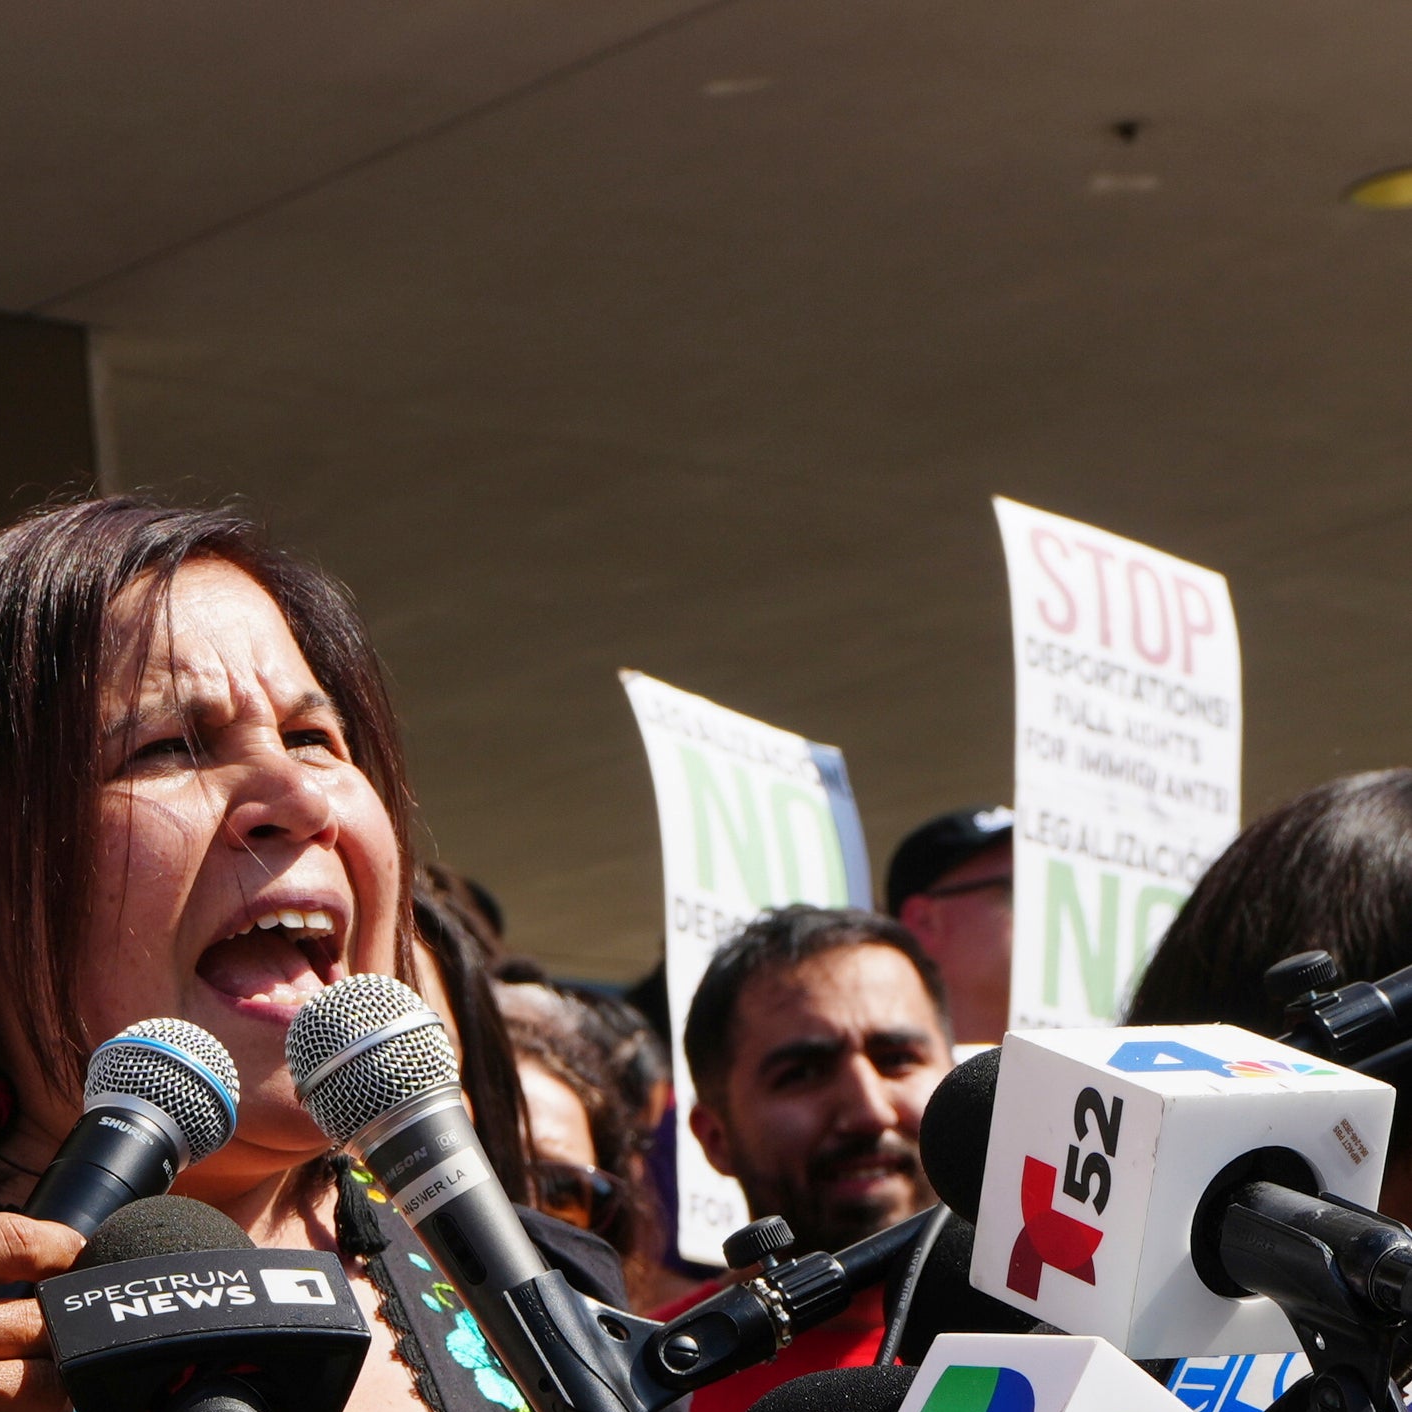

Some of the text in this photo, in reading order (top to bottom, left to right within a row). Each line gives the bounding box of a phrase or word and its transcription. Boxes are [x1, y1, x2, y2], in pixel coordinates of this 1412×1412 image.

[1029, 527, 1215, 677] STOP
[679, 744, 850, 909] NO
[1019, 806, 1203, 886] LEGALIZACIÓ
[98, 1116, 149, 1145] SHURE
[1063, 1086, 1124, 1217] 52
[402, 1169, 466, 1217] ANSWER LA
[909, 1247, 922, 1273] LIVE
[64, 1269, 249, 1312] SPECTRUM
[110, 1286, 256, 1323] NEWS
[898, 1276, 914, 1310] WIRE
